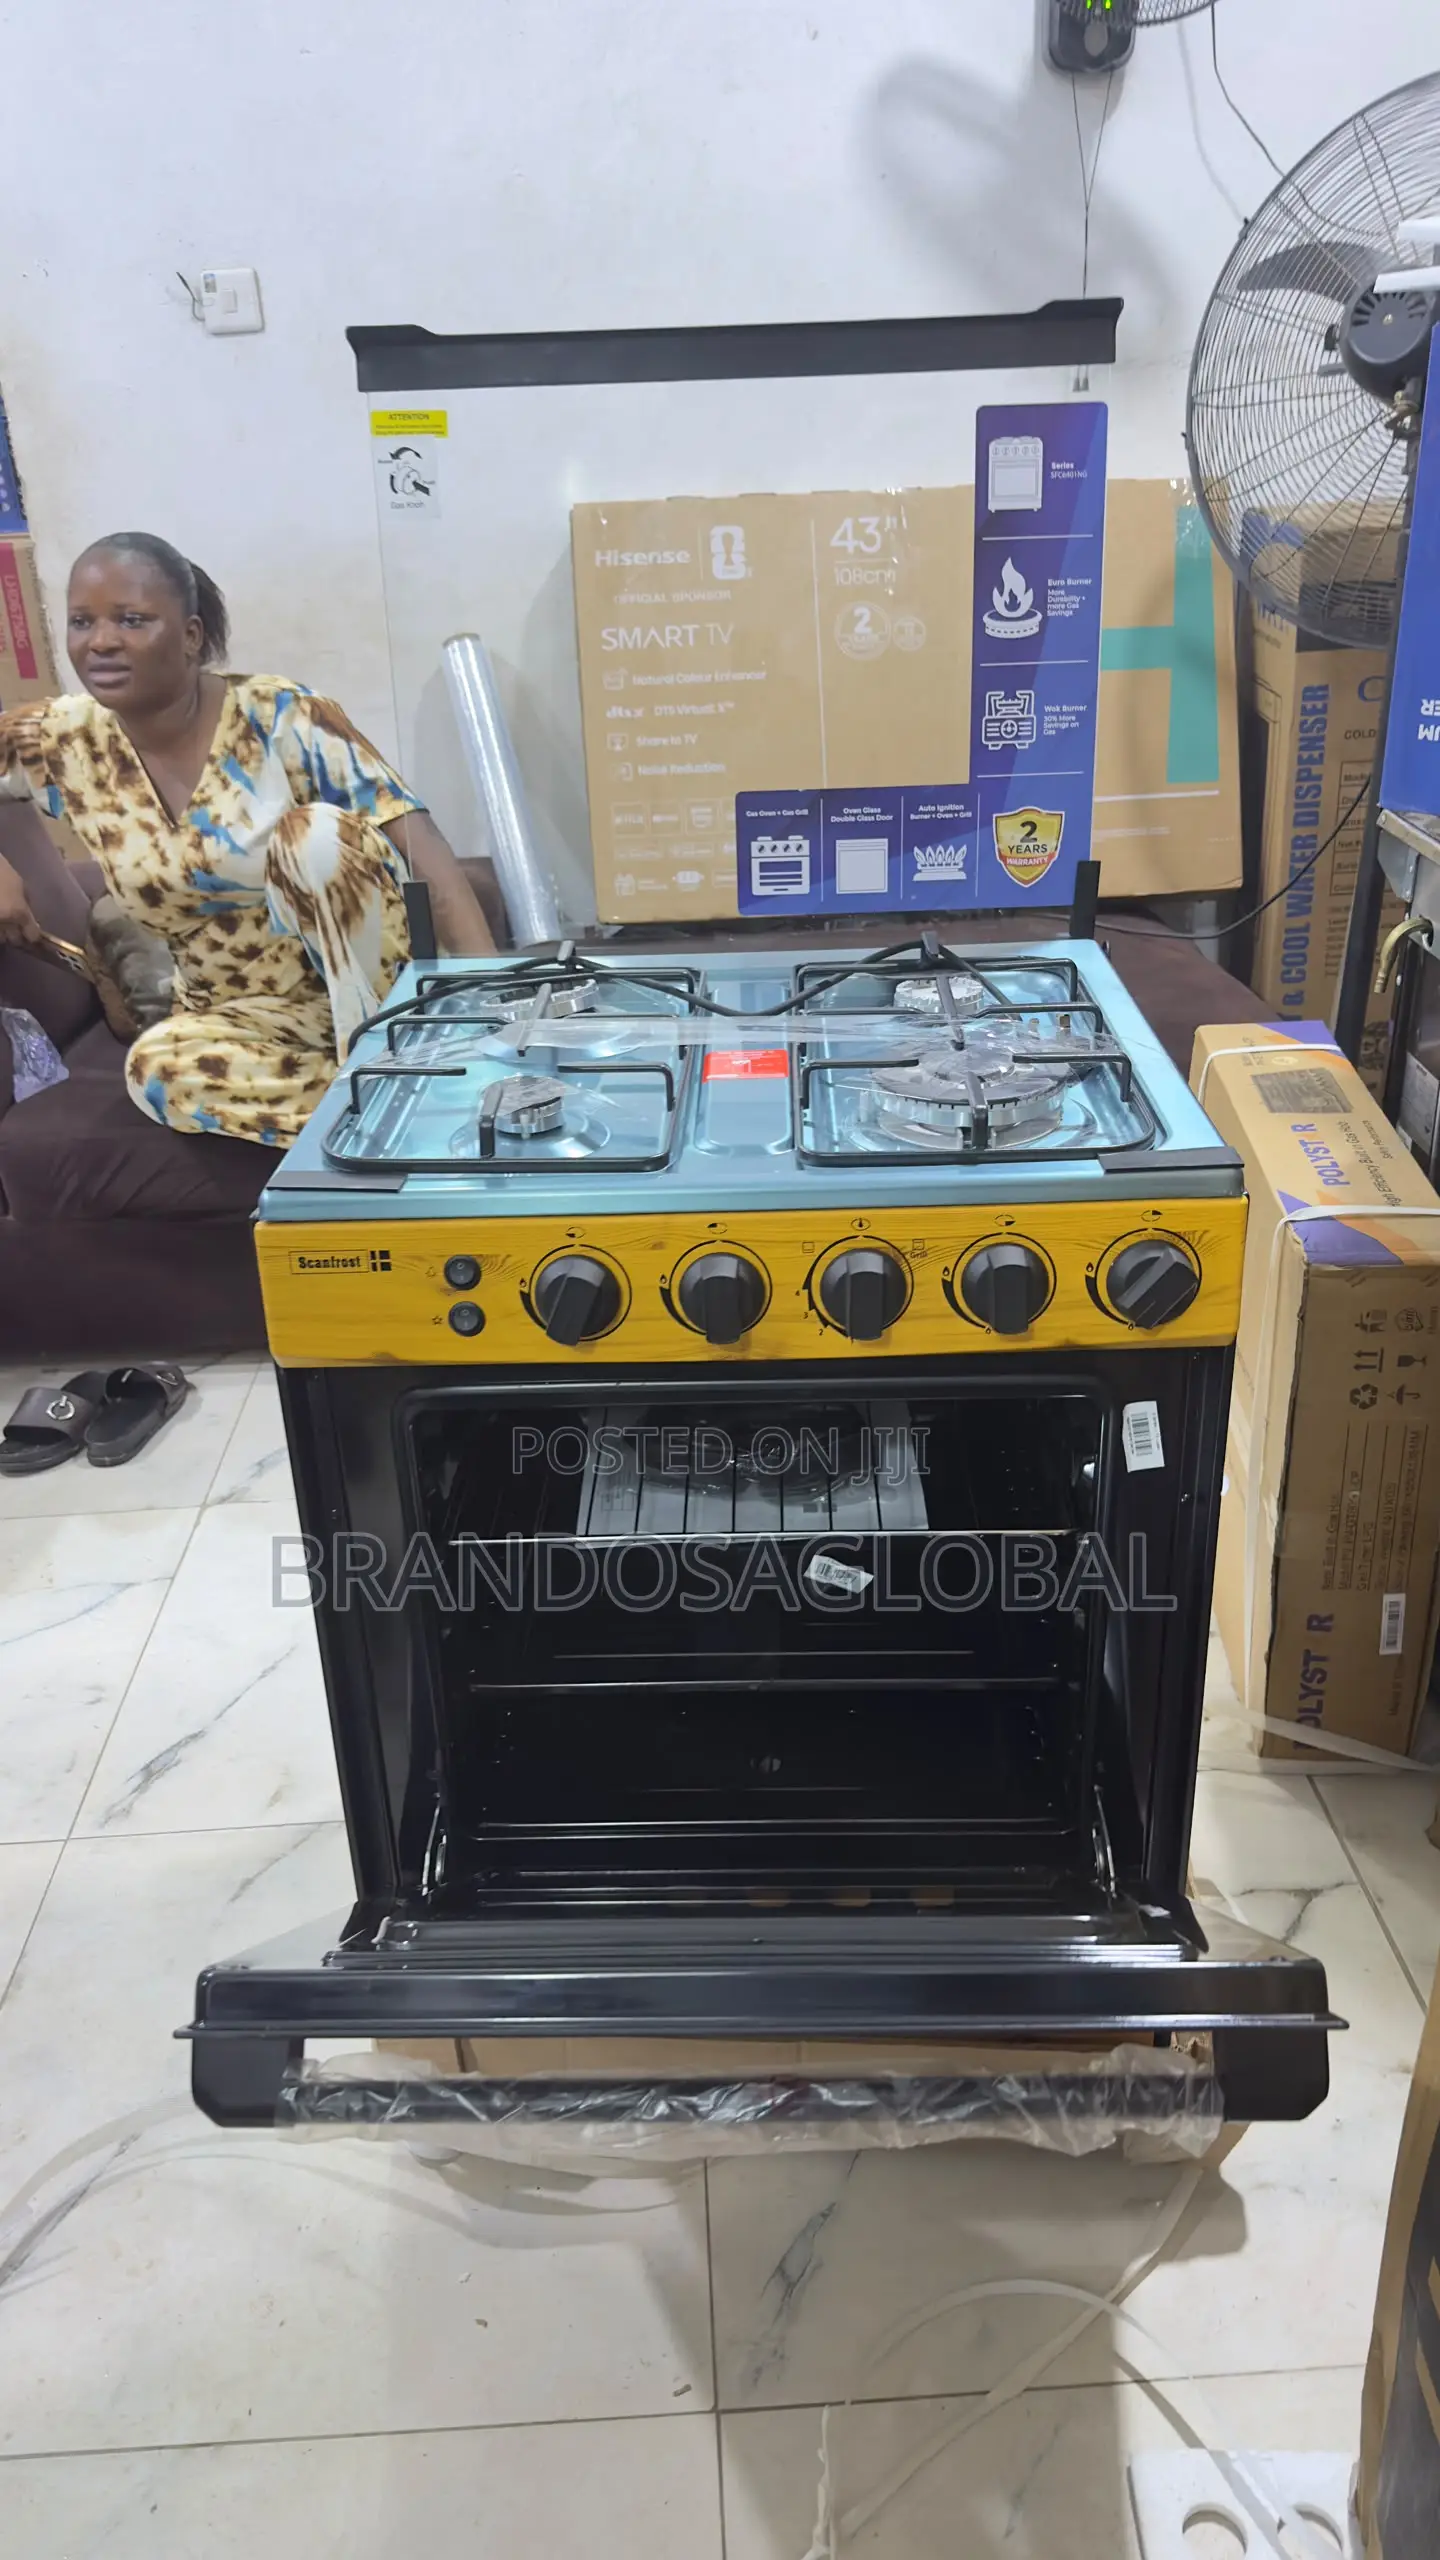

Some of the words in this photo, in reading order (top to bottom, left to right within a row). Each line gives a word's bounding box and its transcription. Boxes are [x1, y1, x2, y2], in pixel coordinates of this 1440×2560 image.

[595, 549, 691, 567] Hisense
[834, 567, 897, 586] 108cm
[1066, 578, 1092, 586] Burner
[613, 592, 668, 605] OFFICIAL
[673, 589, 732, 603] SPONSOR
[601, 624, 700, 651] SMART
[704, 621, 734, 646] TV
[632, 673, 675, 685] Natural
[1062, 704, 1088, 712] Burner
[636, 735, 669, 747] Share
[683, 733, 698, 745] TV
[1292, 684, 1329, 828] DISPENSER
[918, 804, 936, 812] Auto
[937, 803, 964, 813] Ignition
[830, 815, 856, 823] Double
[857, 814, 875, 822] Glass
[1019, 820, 1038, 843] 2
[1007, 844, 1048, 854] YEARS
[1006, 857, 1048, 866] WARRANTY
[1286, 834, 1318, 918] WATER
[1281, 922, 1311, 984] COOL
[298, 1256, 361, 1269] Scanfrost
[803, 1311, 809, 1320] 3
[818, 1328, 824, 1337] 2
